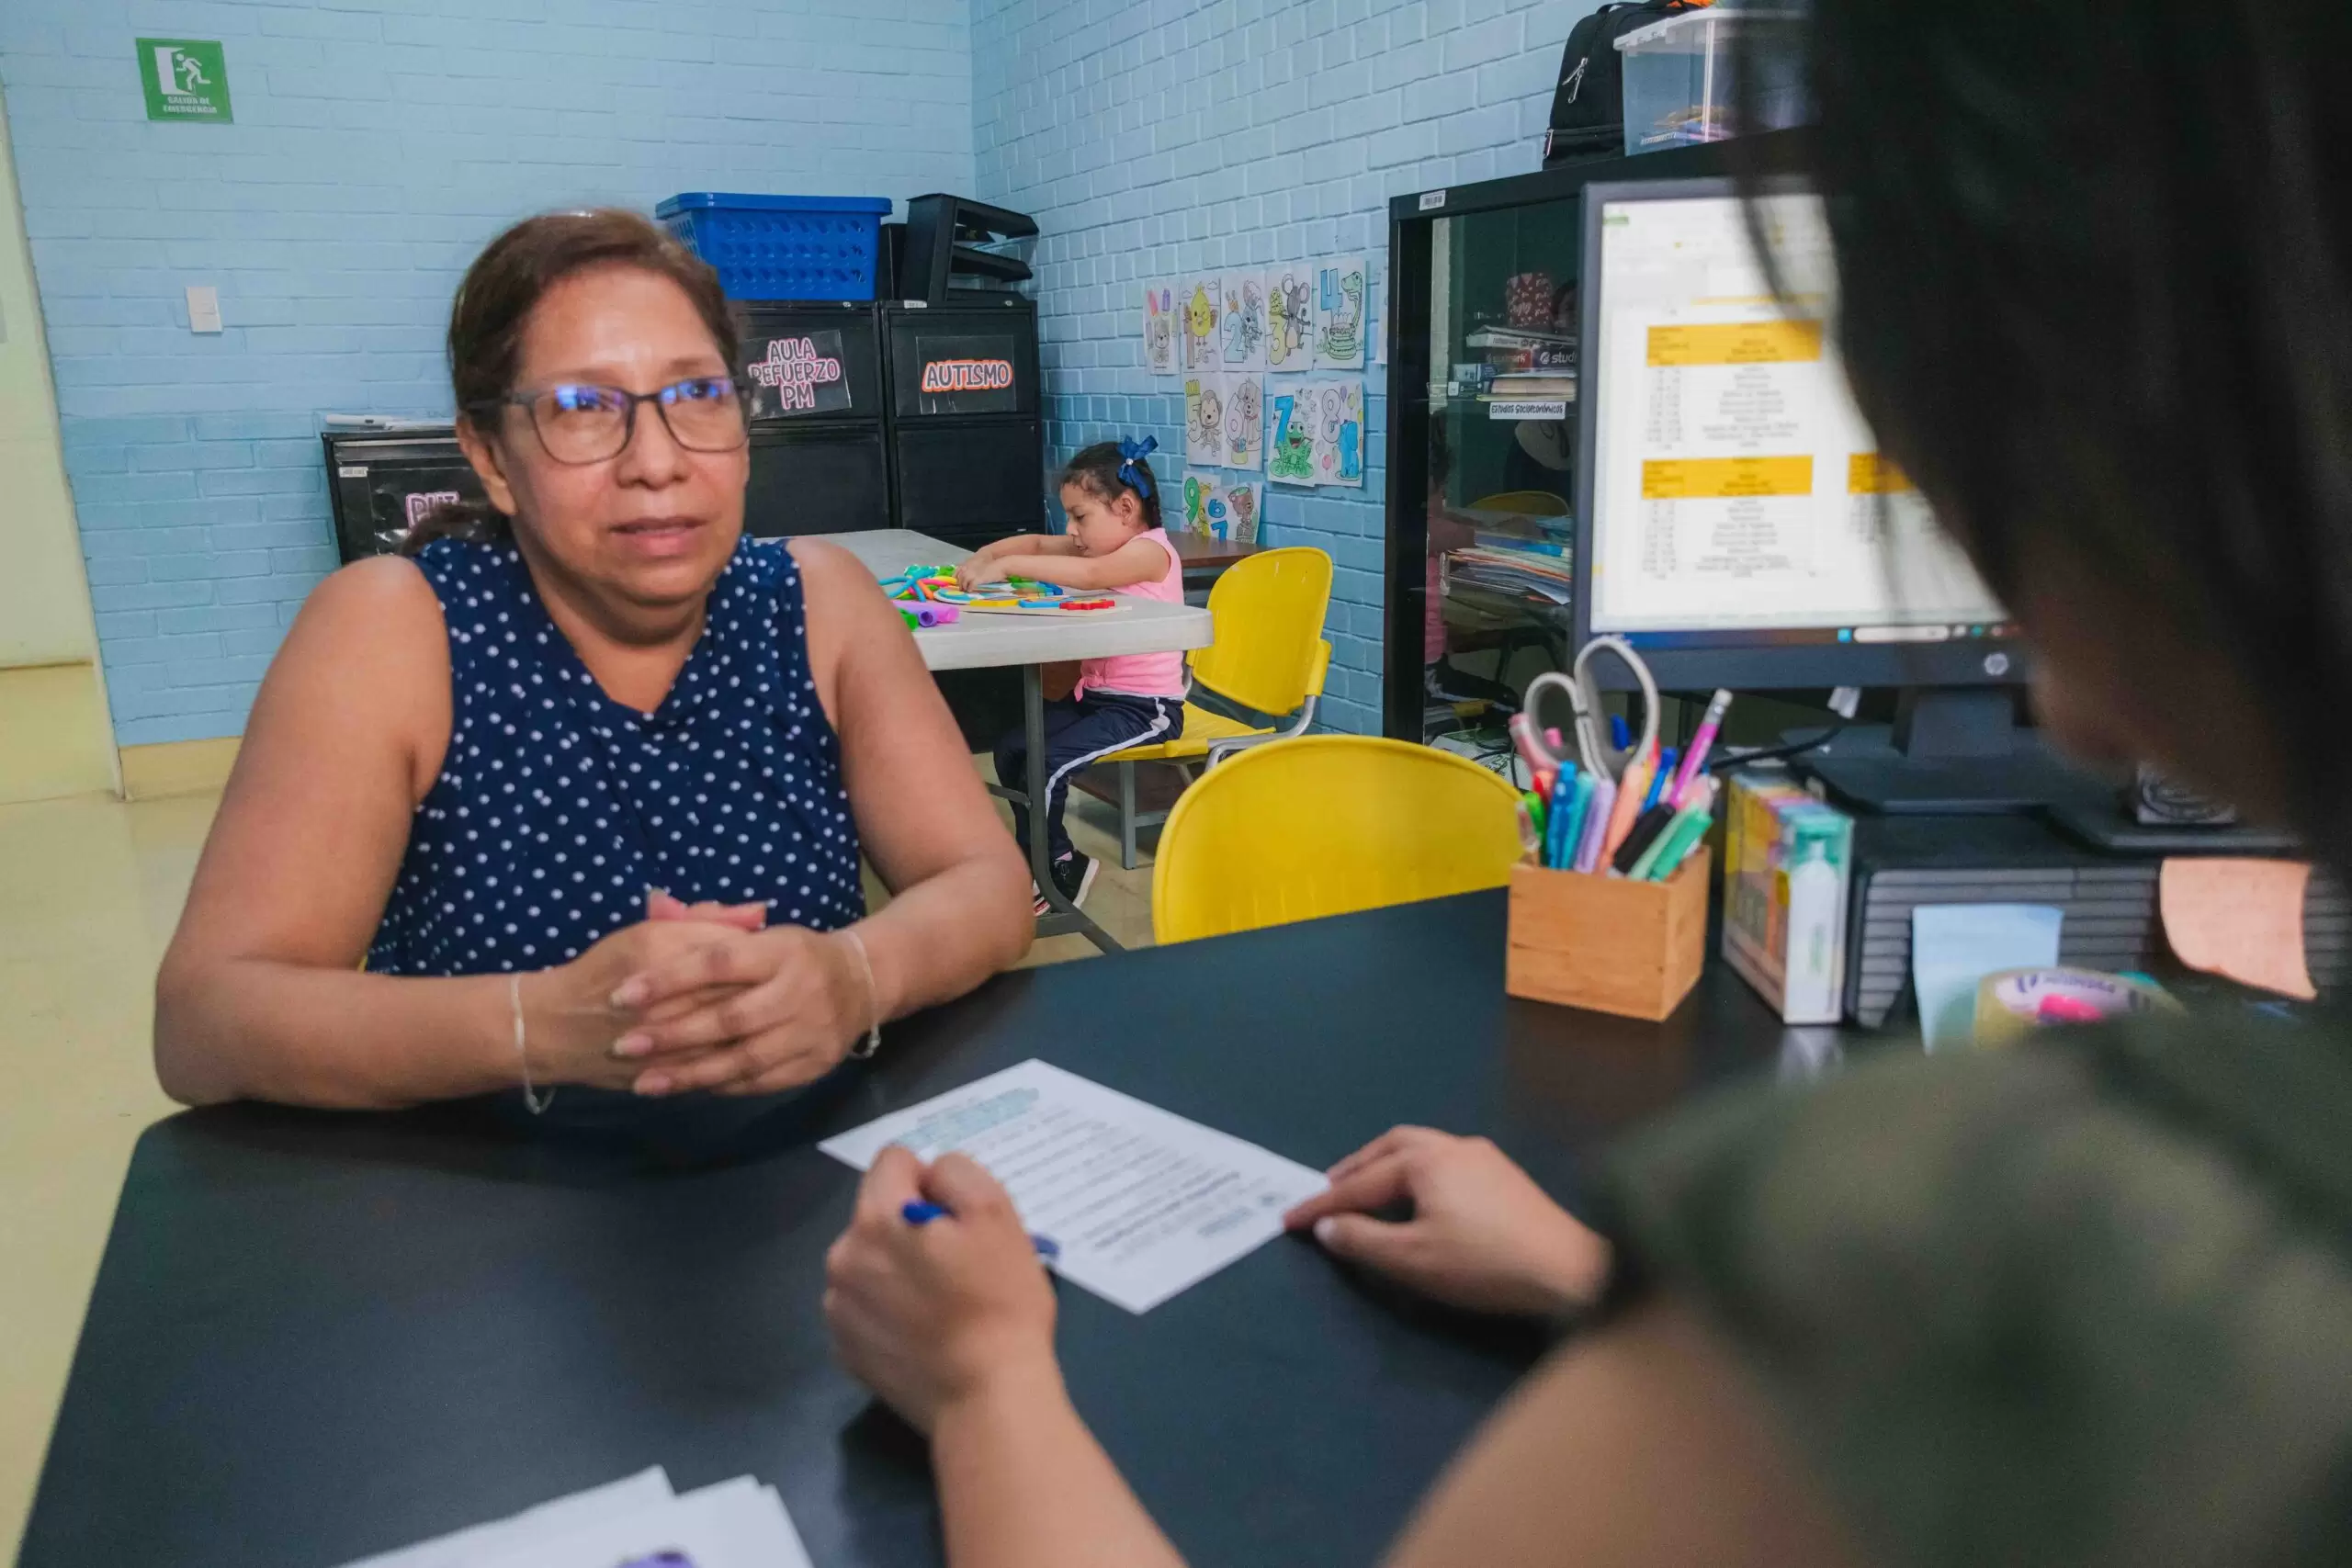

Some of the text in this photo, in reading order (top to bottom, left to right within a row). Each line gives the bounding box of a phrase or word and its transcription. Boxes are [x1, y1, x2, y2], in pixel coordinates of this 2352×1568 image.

[1320, 268, 1343, 323] 4
[768, 338, 816, 364] AULA
[1224, 311, 1245, 364] 2
[1269, 310, 1287, 366] 3
[749, 359, 840, 386] REFUERZO
[781, 383, 815, 410] PM
[923, 361, 1012, 389] AUTISMO
[1225, 392, 1244, 442] 6
[1274, 395, 1294, 449] 7
[1321, 389, 1340, 444] 8
[1184, 477, 1201, 525] 9
[1208, 499, 1227, 519] 6
[1211, 520, 1228, 544] 7
